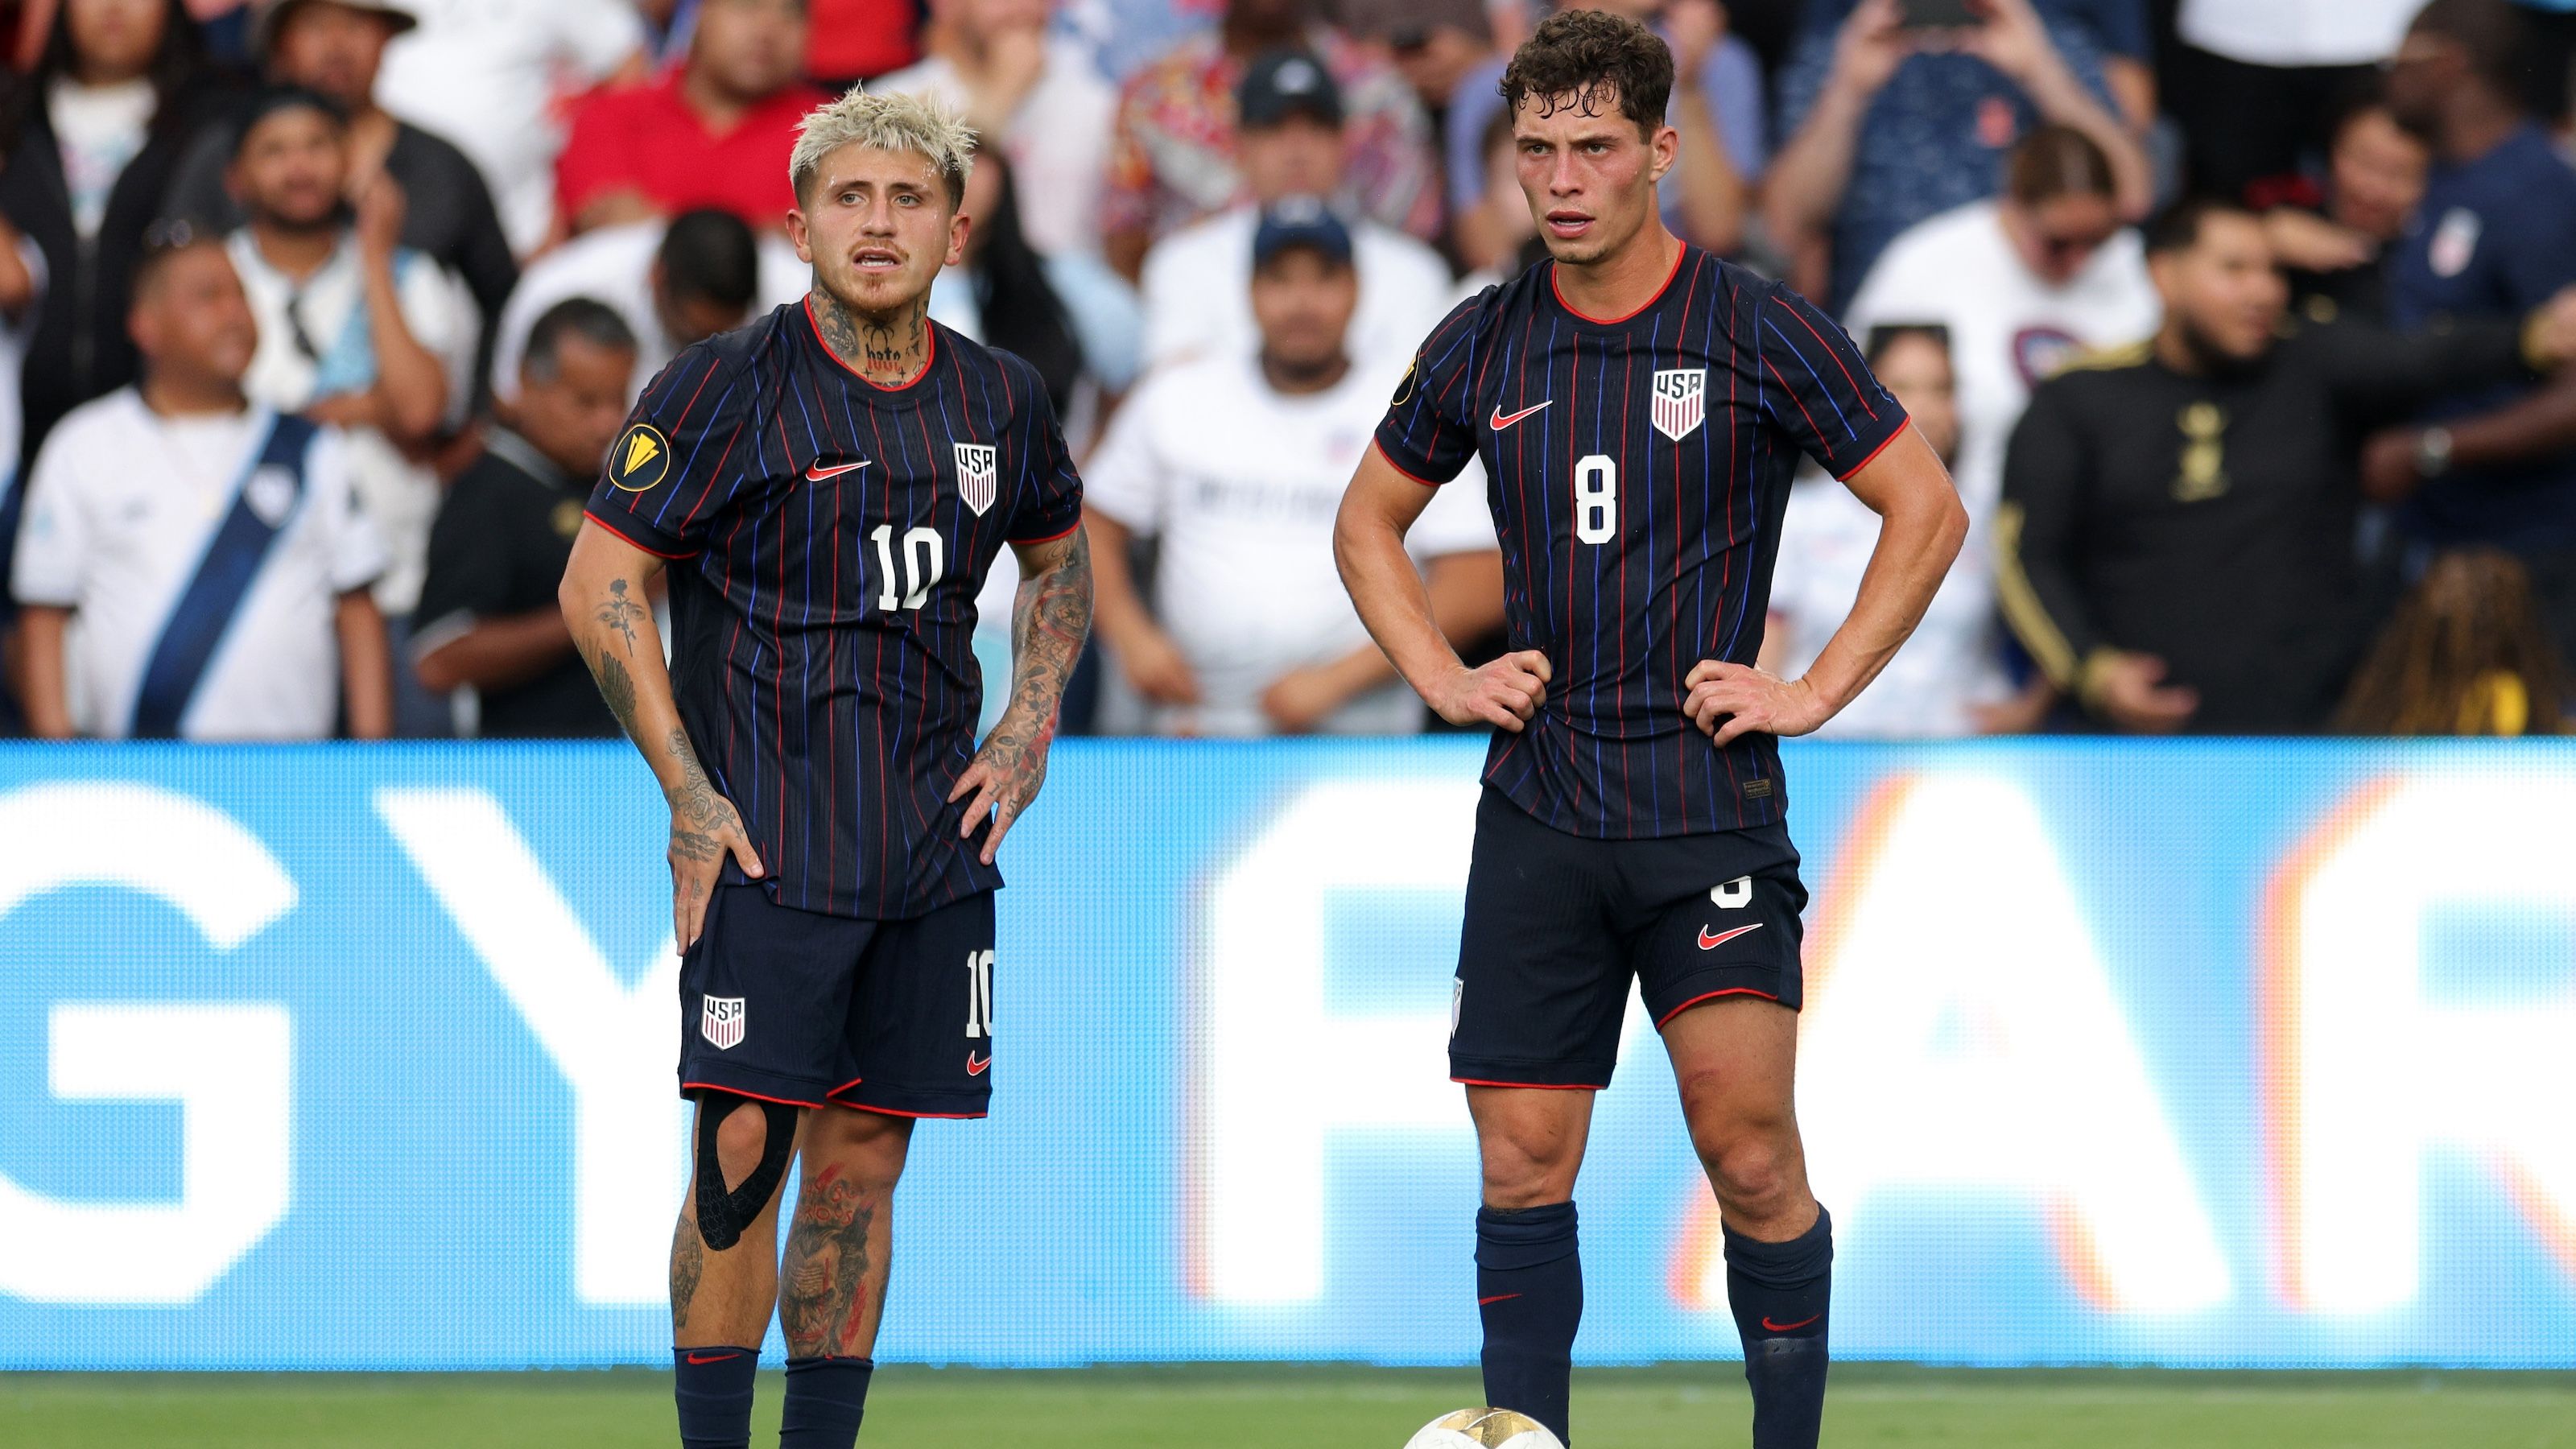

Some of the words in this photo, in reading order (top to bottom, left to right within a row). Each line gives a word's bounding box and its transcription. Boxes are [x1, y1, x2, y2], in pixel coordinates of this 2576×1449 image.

[1657, 374, 1702, 399] USA
[958, 447, 993, 475] USA
[1575, 455, 1616, 544] 8
[869, 523, 943, 612] 10
[706, 998, 741, 1022] USA
